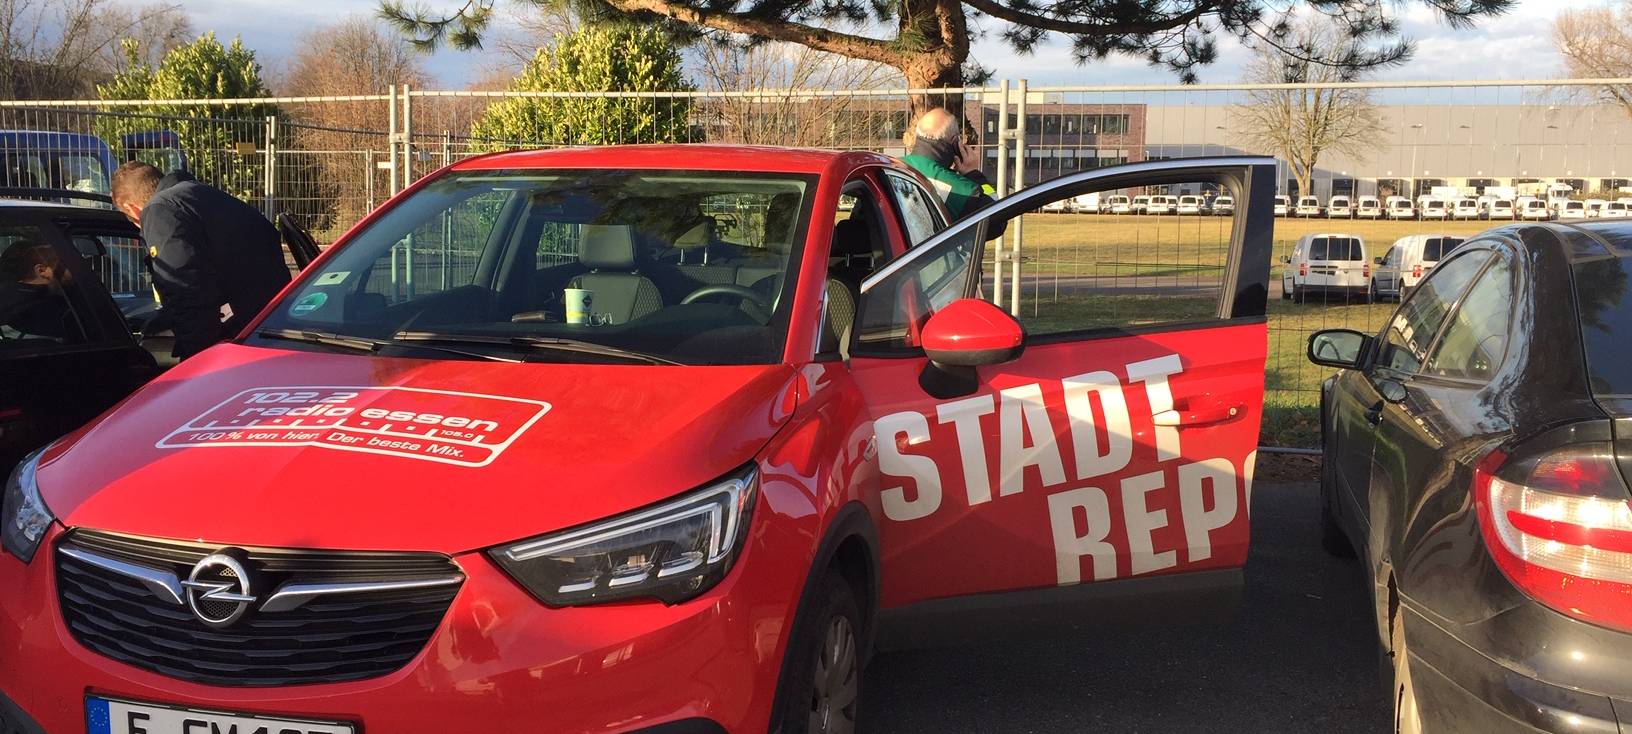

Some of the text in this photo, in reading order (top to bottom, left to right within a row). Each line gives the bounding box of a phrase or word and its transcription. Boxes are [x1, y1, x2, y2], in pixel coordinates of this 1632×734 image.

[244, 391, 360, 404] 102.2
[238, 403, 499, 433] radio essen
[326, 432, 365, 444] Der
[367, 436, 422, 451] beste
[425, 443, 464, 458] Mix.
[873, 354, 1183, 522] STADT
